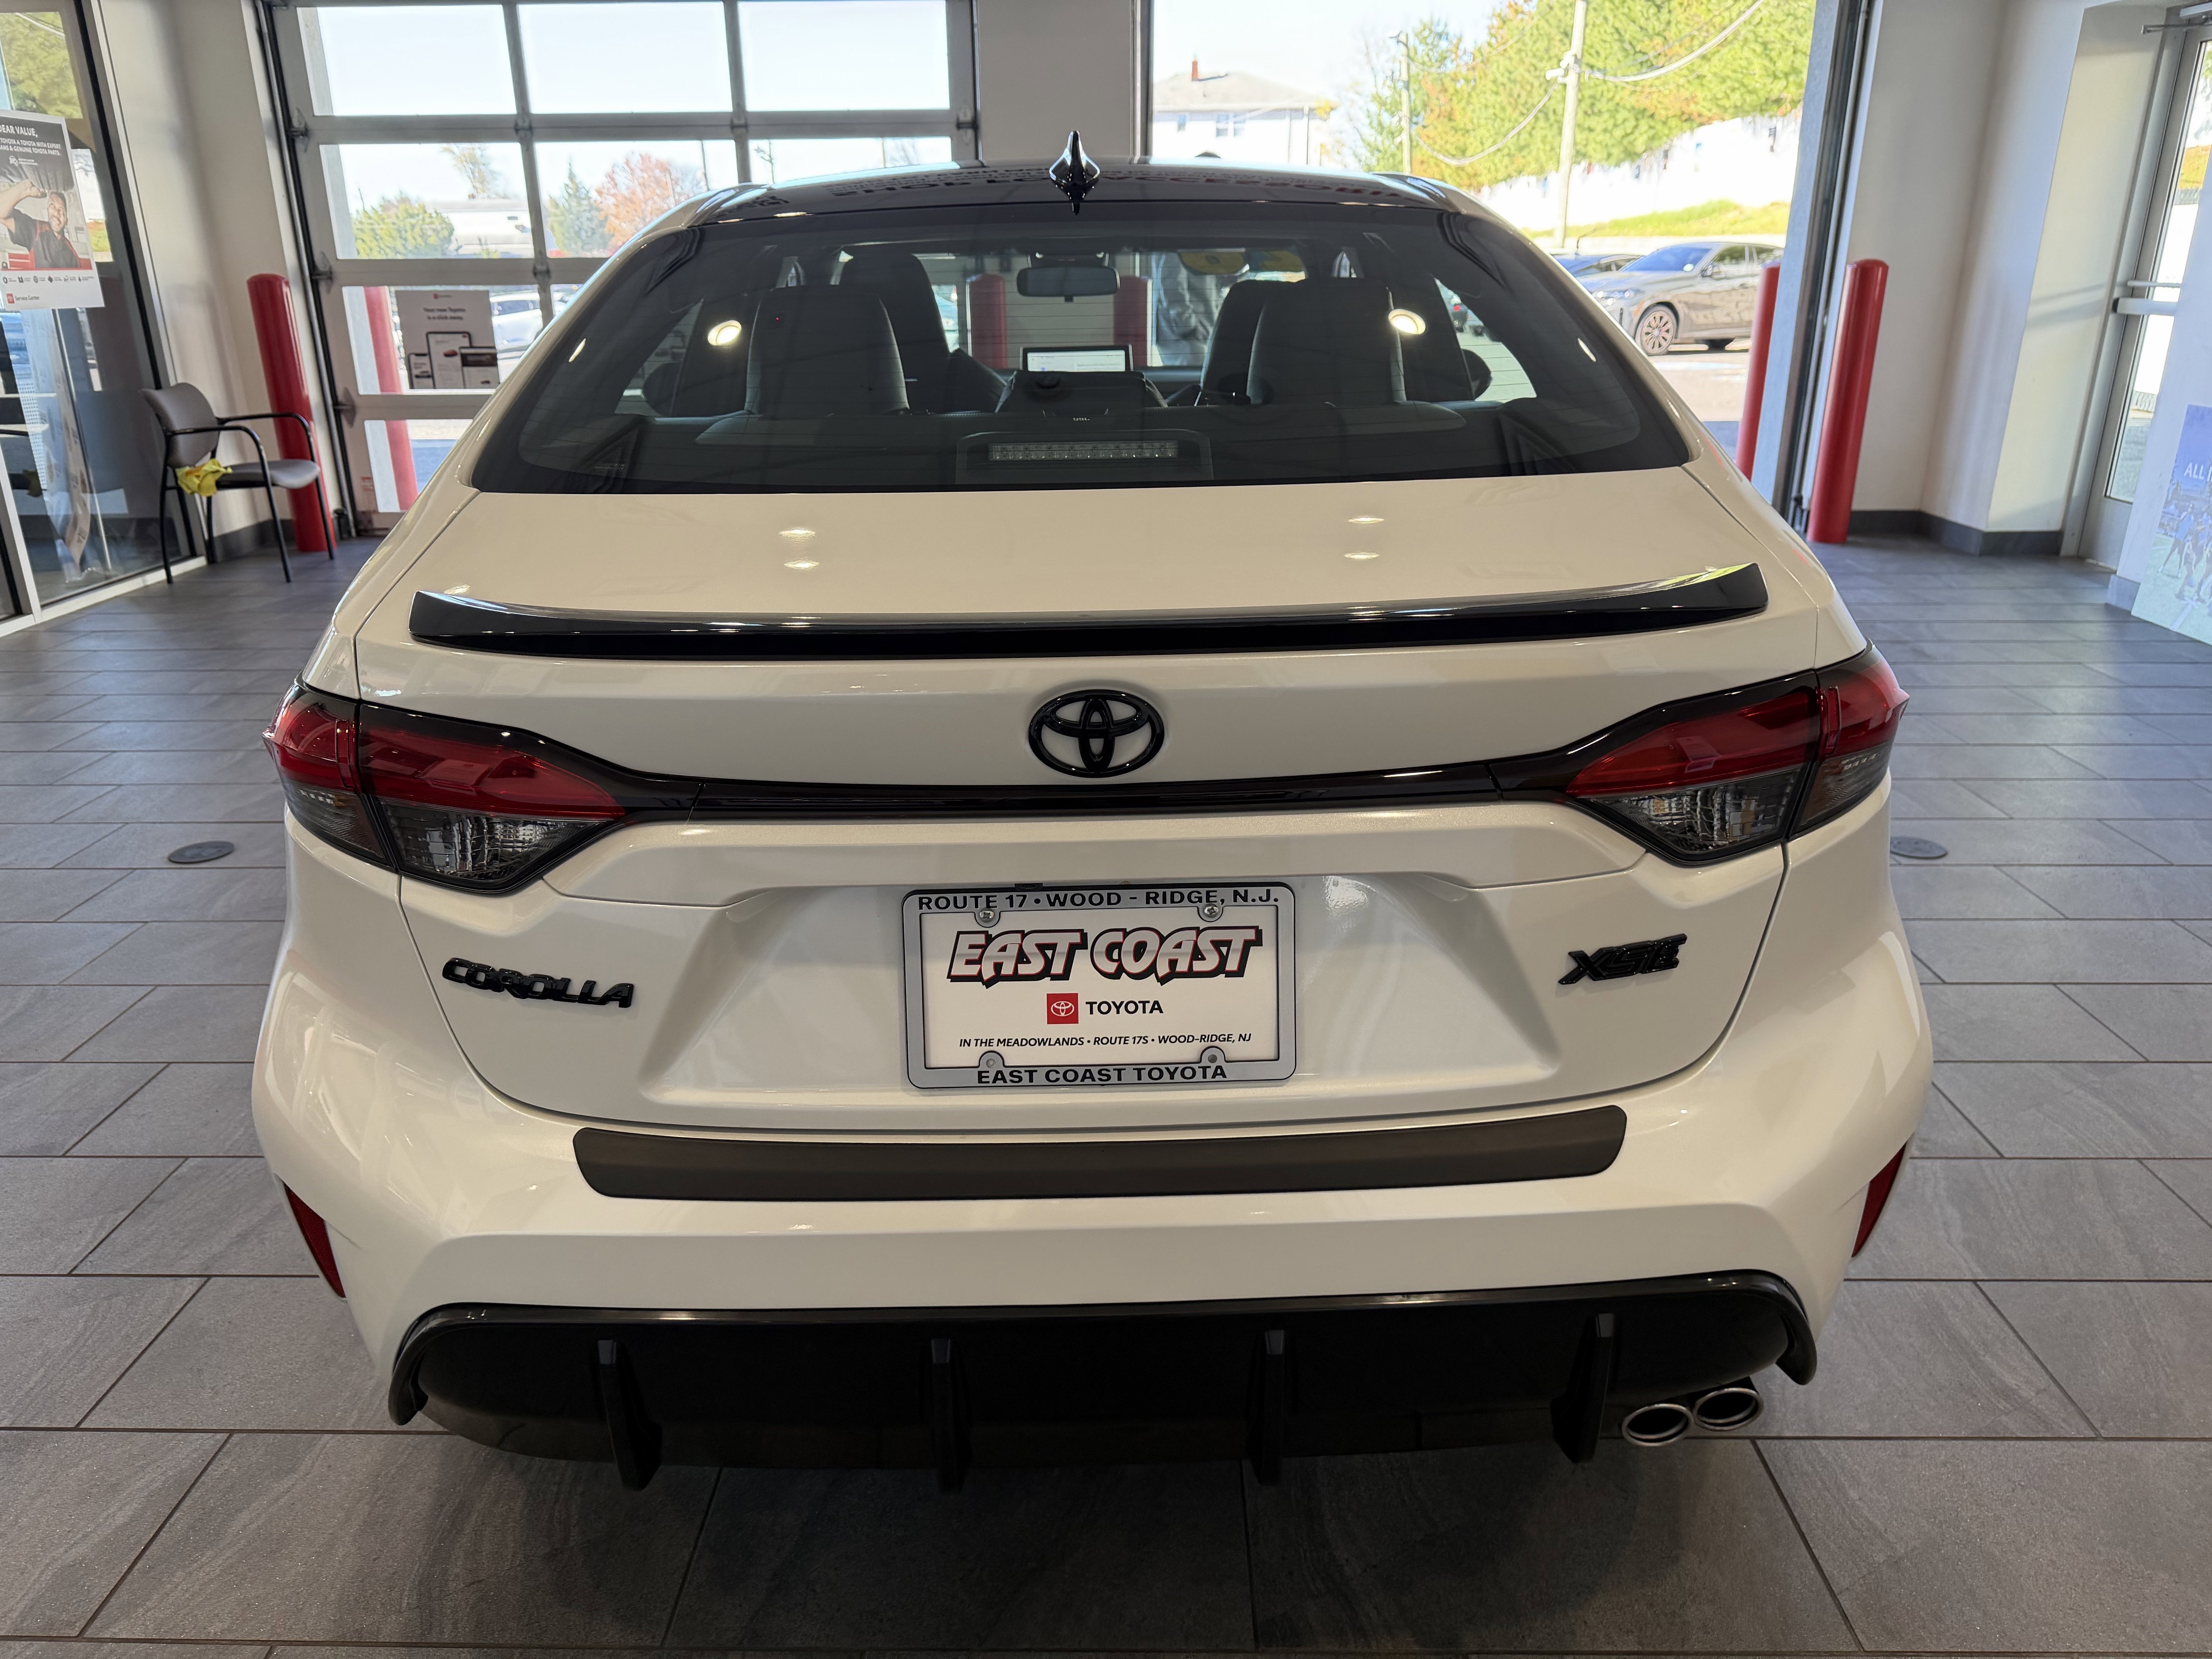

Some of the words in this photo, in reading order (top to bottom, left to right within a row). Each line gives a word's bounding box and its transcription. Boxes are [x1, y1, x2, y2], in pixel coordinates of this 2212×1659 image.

[15, 126, 38, 137] VALUE,
[2184, 462, 2205, 480] ALL
[919, 895, 998, 910] ROUTE
[1005, 894, 1027, 908] 17
[1046, 892, 1121, 907] WOOD
[1145, 890, 1225, 905] RIDGE,
[1233, 889, 1279, 903] N.J.
[947, 929, 1088, 989] EAST
[1090, 926, 1263, 986] COAST
[1558, 933, 1688, 985] XSE
[442, 957, 634, 1008] COROLLA
[1085, 1000, 1164, 1015] TOYOTA
[959, 1039, 972, 1047] IN
[974, 1038, 994, 1047] THE
[996, 1037, 1085, 1047] MEADOWLANDS
[1093, 1036, 1130, 1045] ROUTE
[1132, 1036, 1149, 1044] 17S
[1158, 1034, 1235, 1044] WOOD-RIDGE,
[1238, 1033, 1252, 1042] NJ
[977, 1069, 1038, 1084] EAST
[1044, 1067, 1126, 1083] COAST
[1132, 1065, 1227, 1081] TOYOTA
